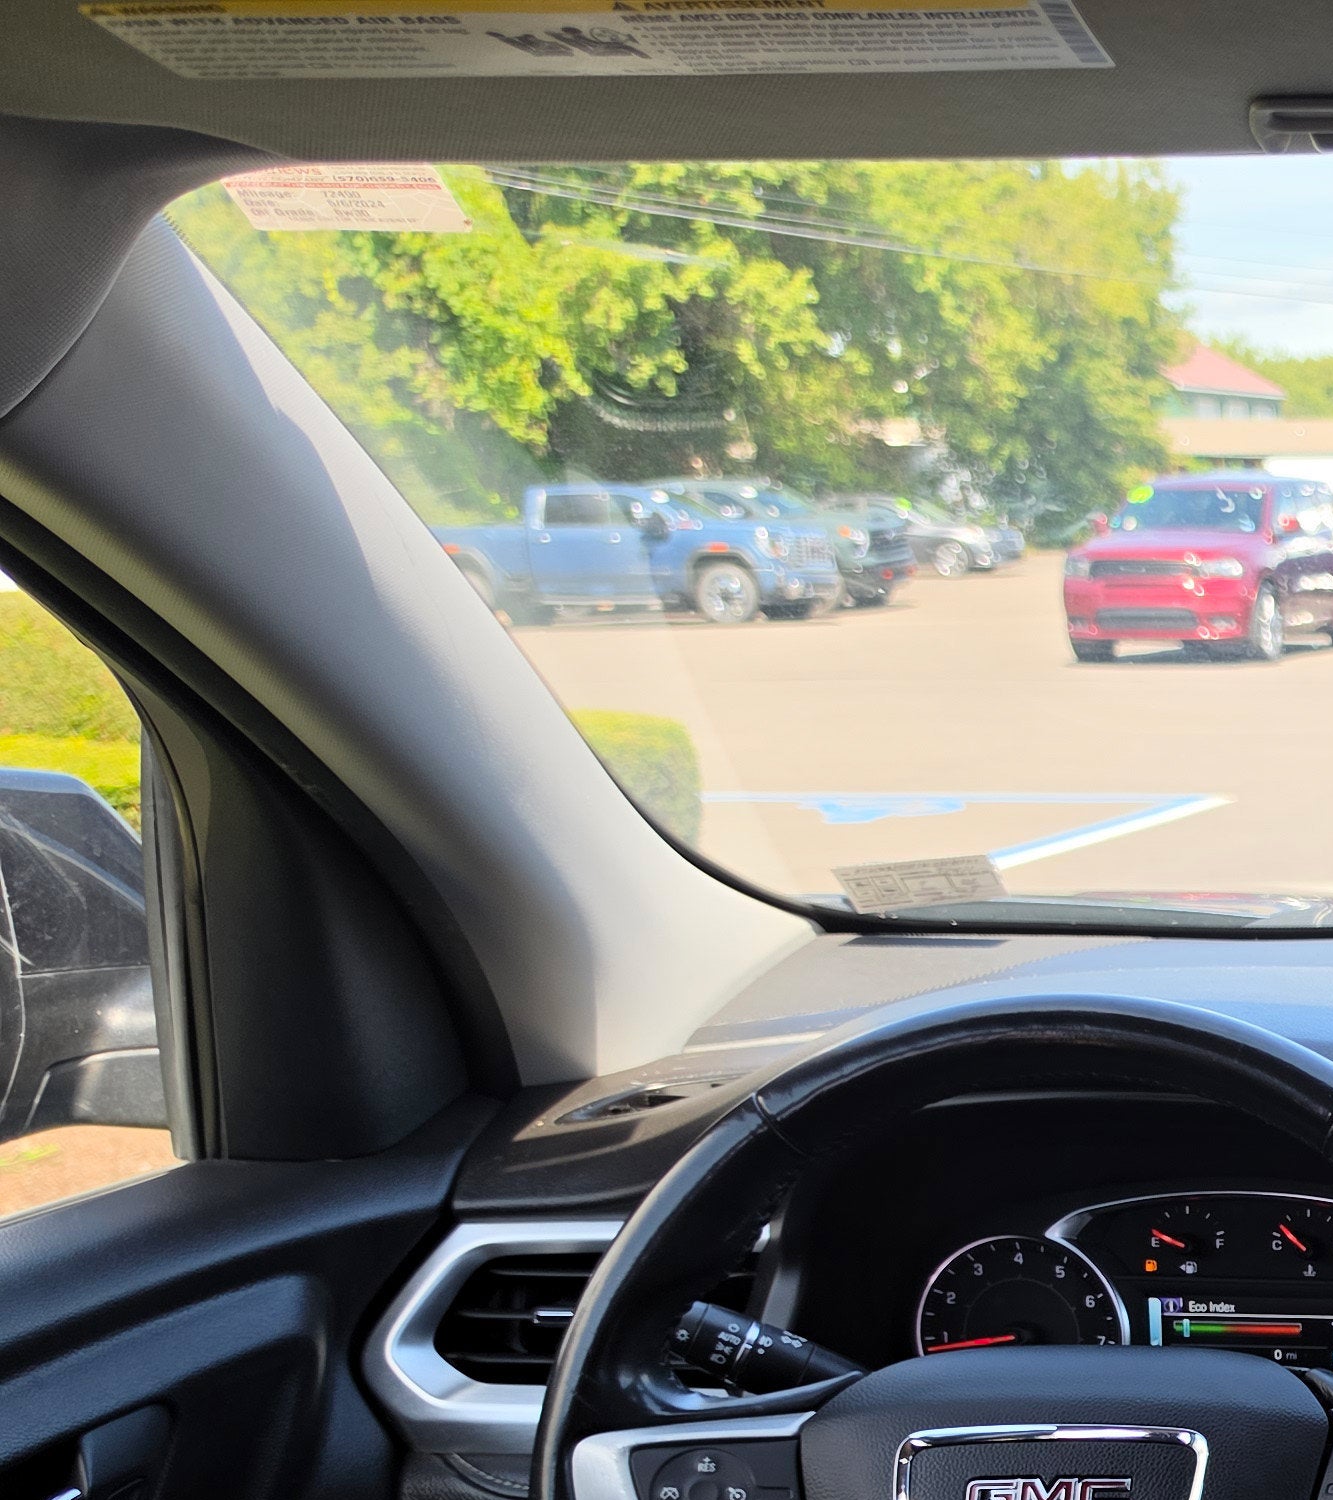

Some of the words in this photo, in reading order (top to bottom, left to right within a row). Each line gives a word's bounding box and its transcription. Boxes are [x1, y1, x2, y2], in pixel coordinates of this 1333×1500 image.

[1151, 1236, 1160, 1248] E
[1215, 1238, 1225, 1249] F
[1271, 1240, 1283, 1251] C
[1013, 1252, 1024, 1265] 4
[973, 1263, 984, 1276] 3
[1055, 1265, 1066, 1279] 5
[946, 1292, 957, 1305] 2
[1085, 1295, 1096, 1308] 6
[1188, 1301, 1208, 1313] Eco
[1209, 1301, 1235, 1313] Index
[1097, 1335, 1106, 1346] 7
[1273, 1348, 1282, 1361] 0
[1285, 1351, 1298, 1360] mi
[697, 1462, 716, 1473] RES
